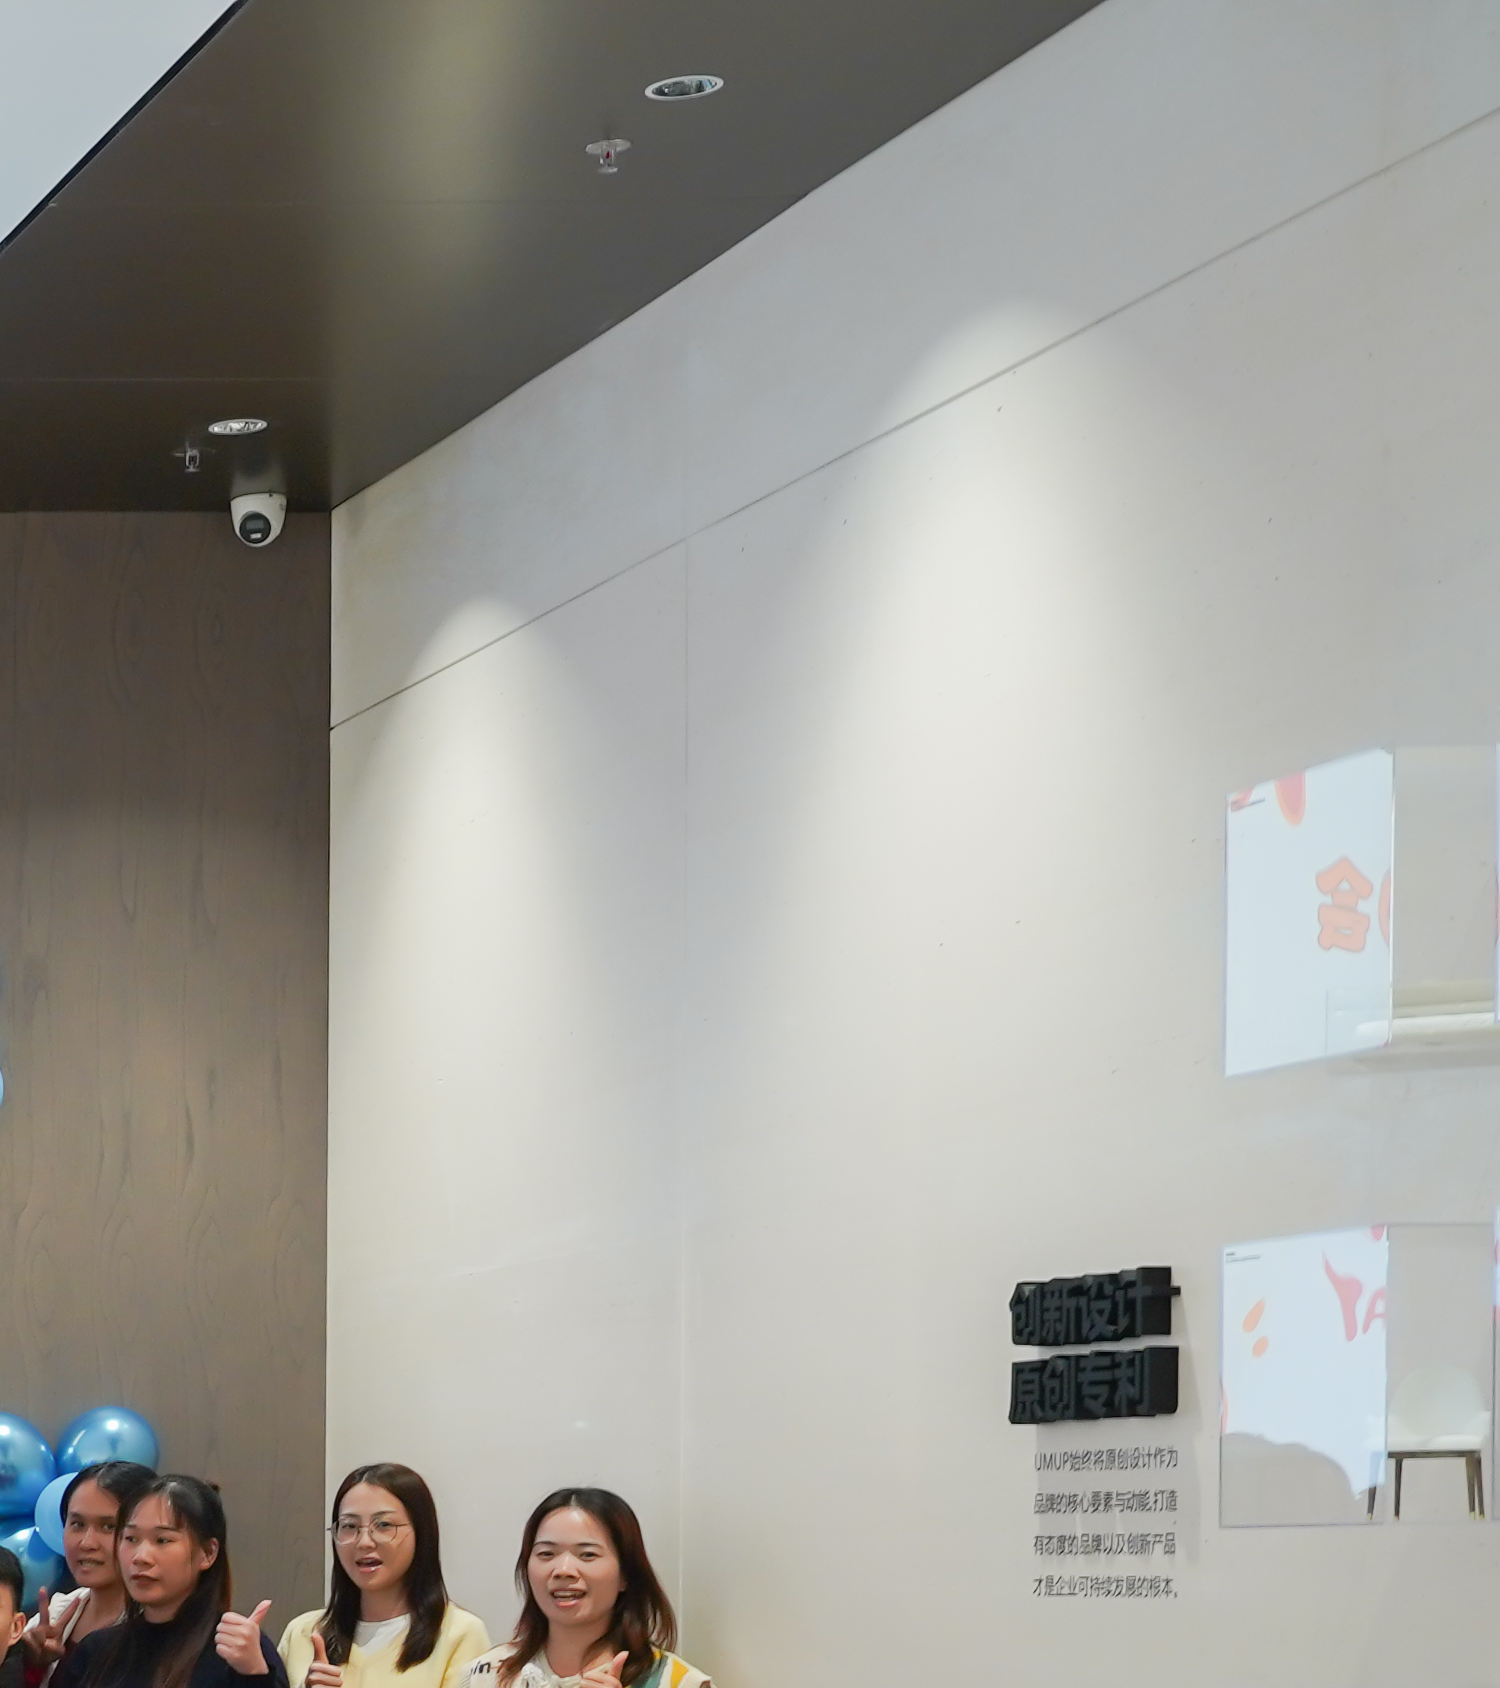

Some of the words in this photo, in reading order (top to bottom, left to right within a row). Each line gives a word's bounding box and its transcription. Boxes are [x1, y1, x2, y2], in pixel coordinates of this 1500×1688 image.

[1010, 1268, 1171, 1346] 创新设计
[1009, 1348, 1177, 1424] 原创专利
